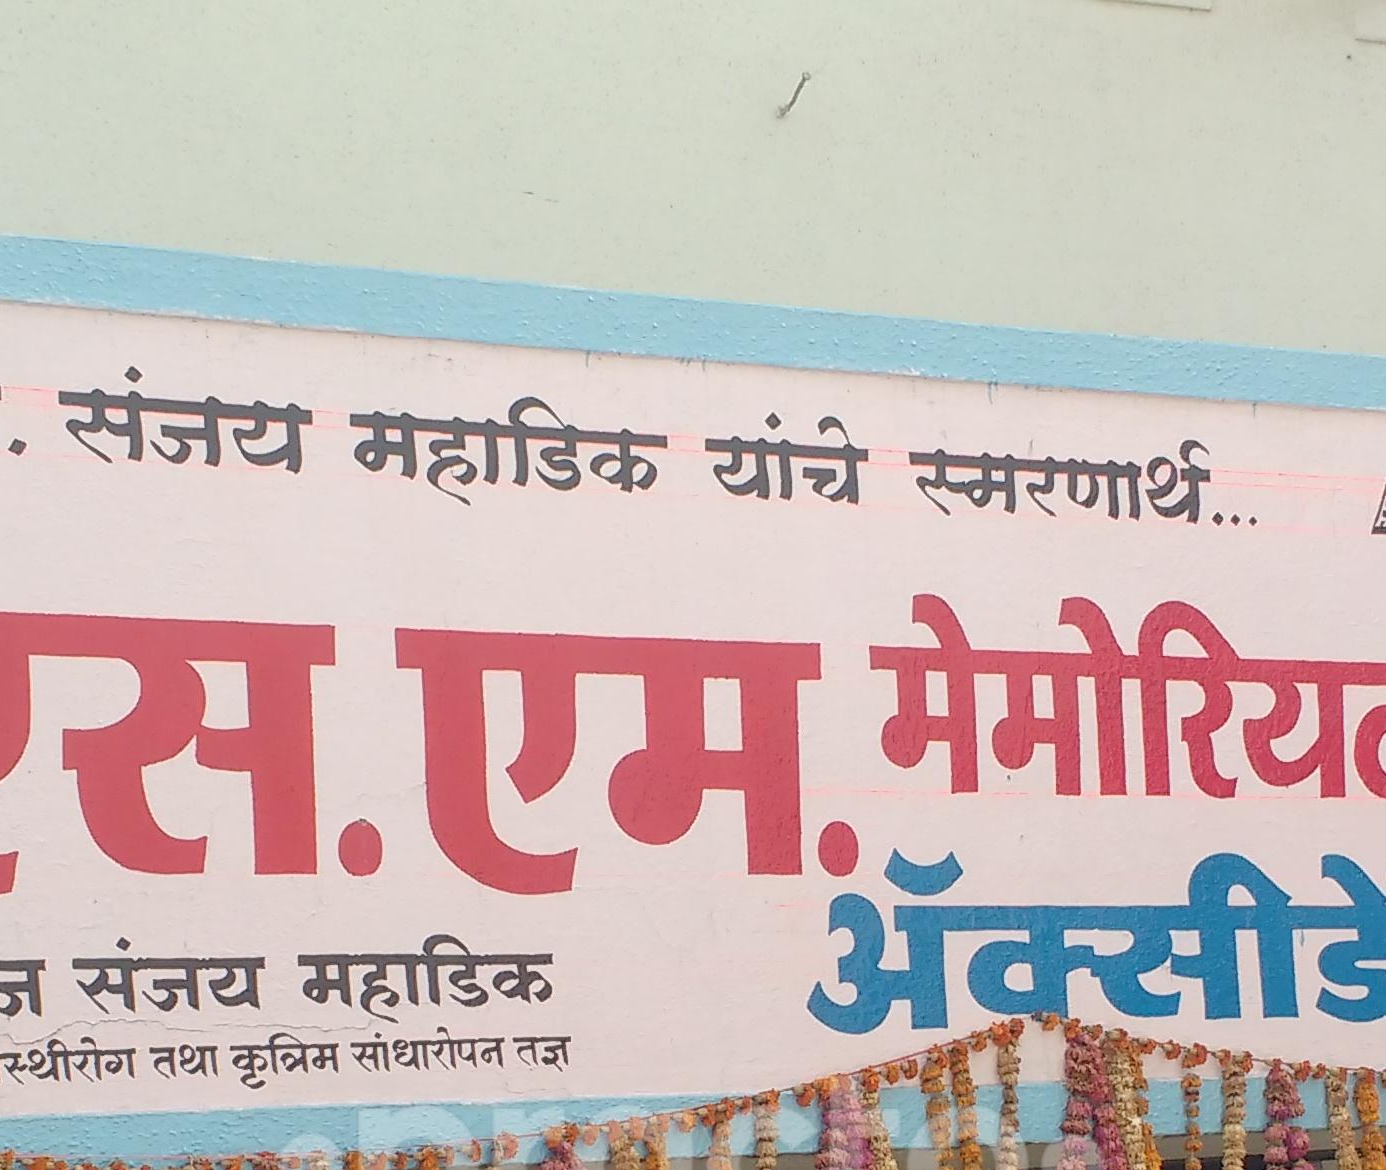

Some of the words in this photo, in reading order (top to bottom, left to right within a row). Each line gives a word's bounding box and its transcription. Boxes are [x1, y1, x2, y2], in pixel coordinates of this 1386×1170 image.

[59, 366, 313, 474] संजय
[350, 396, 668, 506] महाडिक
[705, 413, 869, 505] यांचे
[72, 936, 266, 1015] संजय
[298, 934, 554, 1021] महाडिक
[149, 1044, 219, 1079] तथा
[351, 1026, 505, 1073] सांधारोपन
[513, 1036, 572, 1072] तज्ञ
